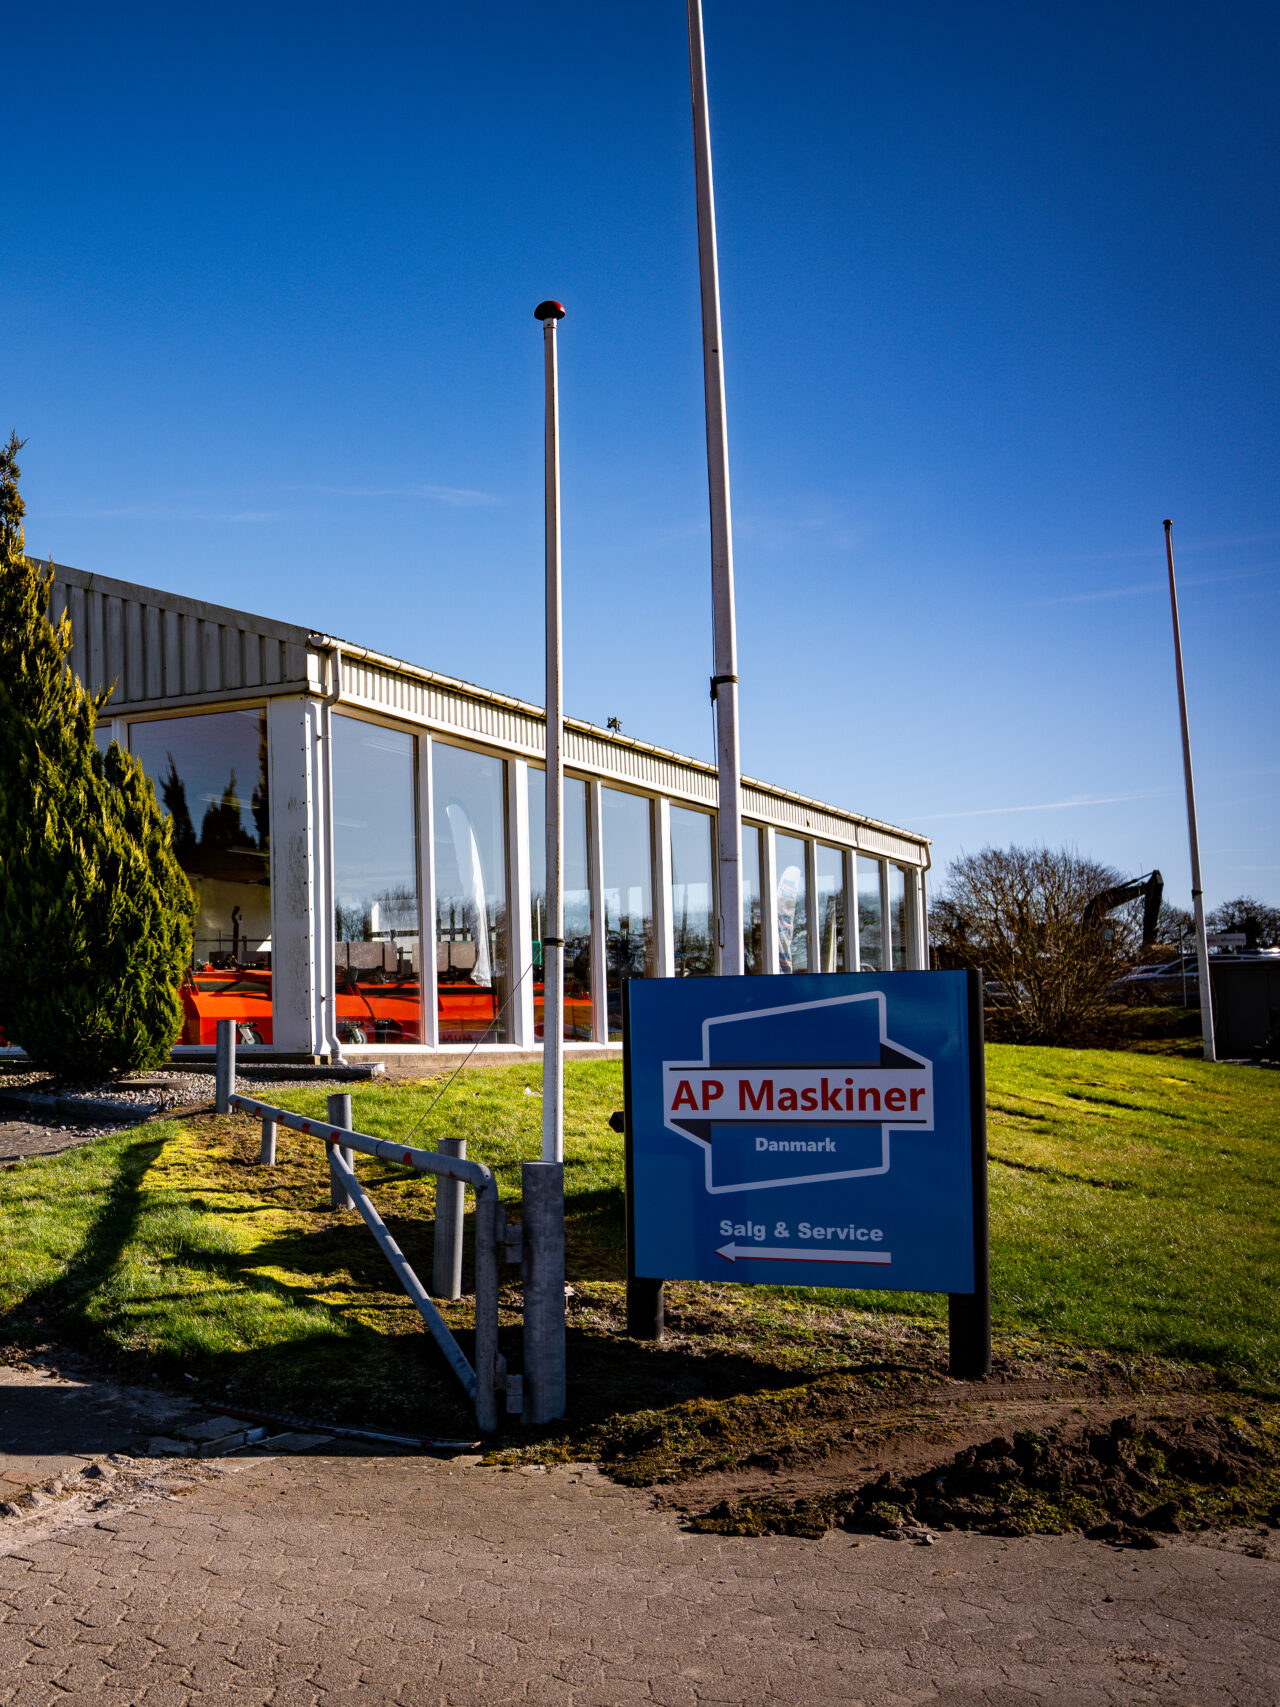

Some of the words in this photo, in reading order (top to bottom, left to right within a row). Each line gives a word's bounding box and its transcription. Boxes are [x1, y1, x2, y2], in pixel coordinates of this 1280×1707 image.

[671, 1080, 724, 1111] AP
[738, 1078, 926, 1112] Maskiner
[755, 1137, 837, 1152] Danmark
[719, 1220, 767, 1241] Salg
[774, 1221, 790, 1238] &
[798, 1222, 884, 1242] Service
